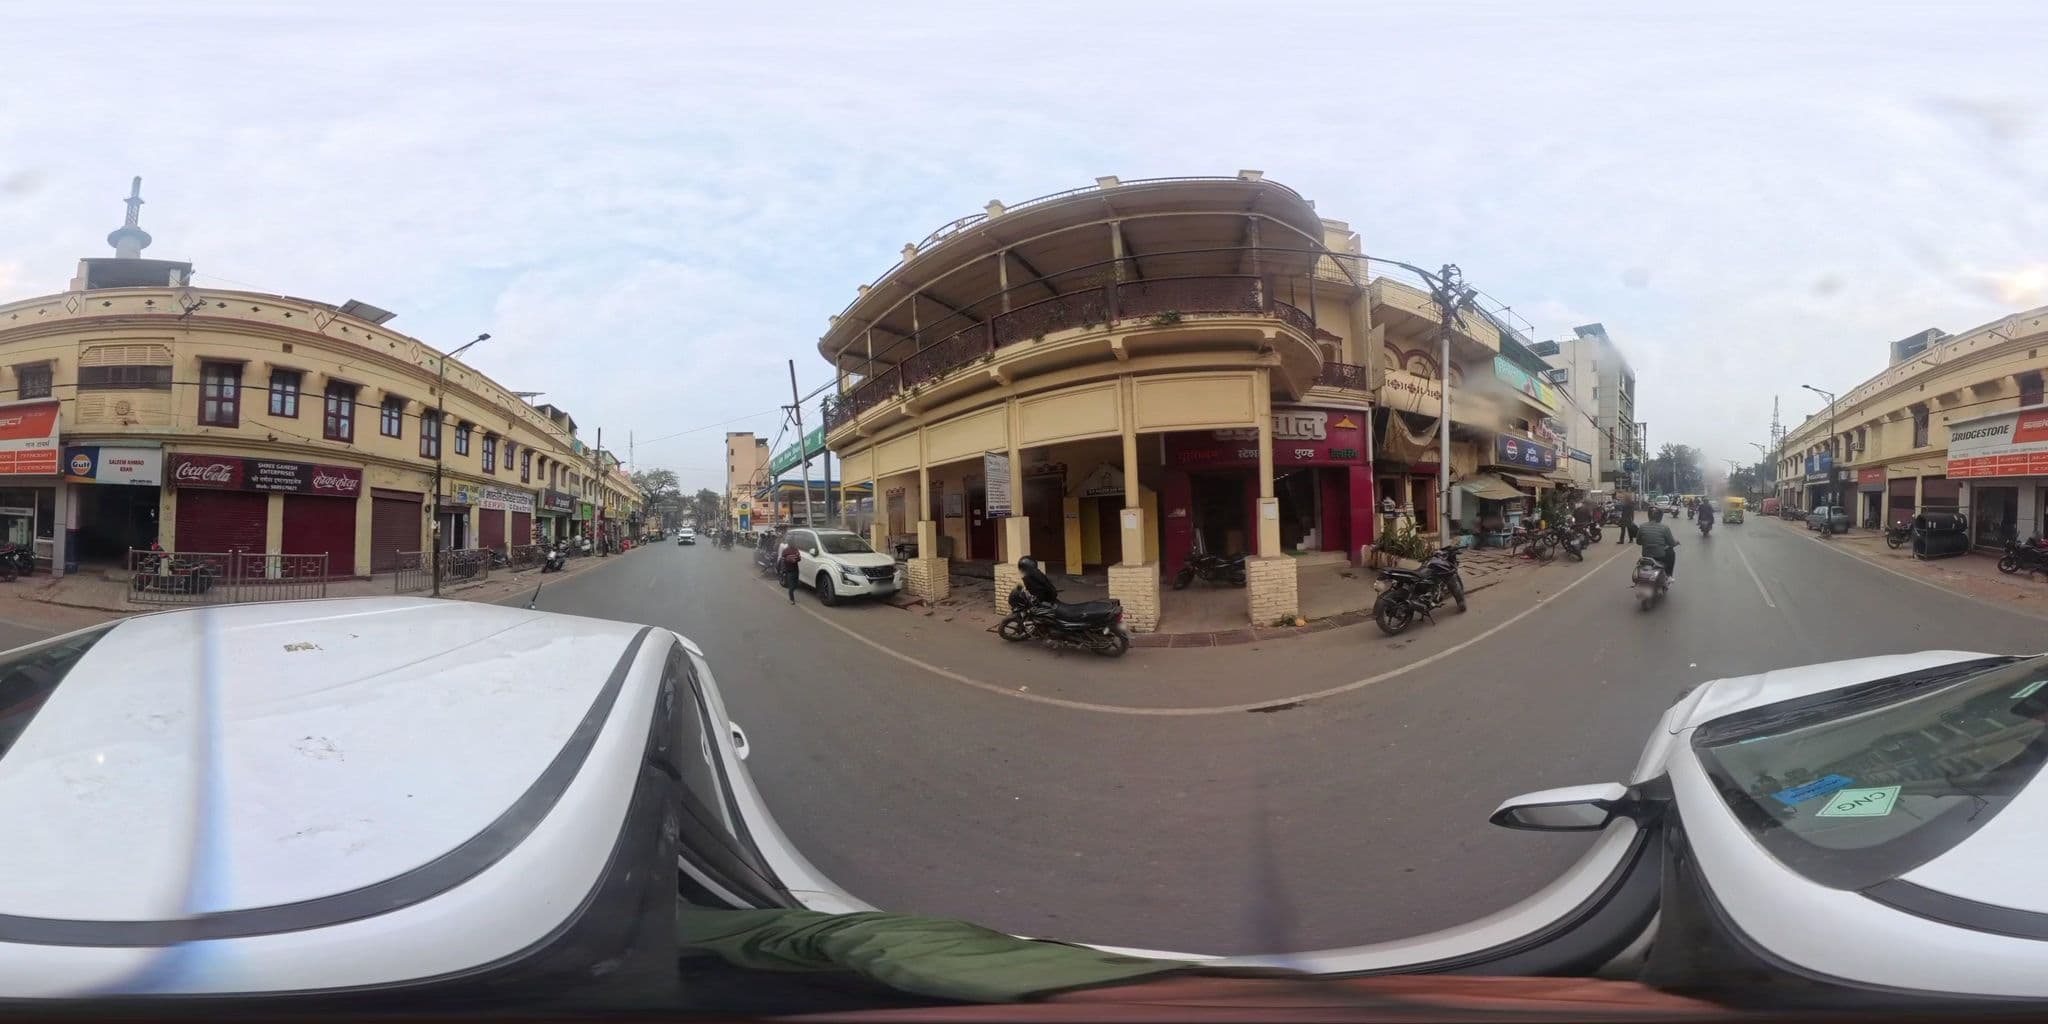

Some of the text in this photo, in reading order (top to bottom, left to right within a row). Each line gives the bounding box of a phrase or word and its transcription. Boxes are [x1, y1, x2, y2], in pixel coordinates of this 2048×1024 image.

[1952, 425, 2010, 442] BRIDGESTONE
[260, 469, 295, 477] ENTERPRISES
[1837, 792, 1886, 811] CNG
